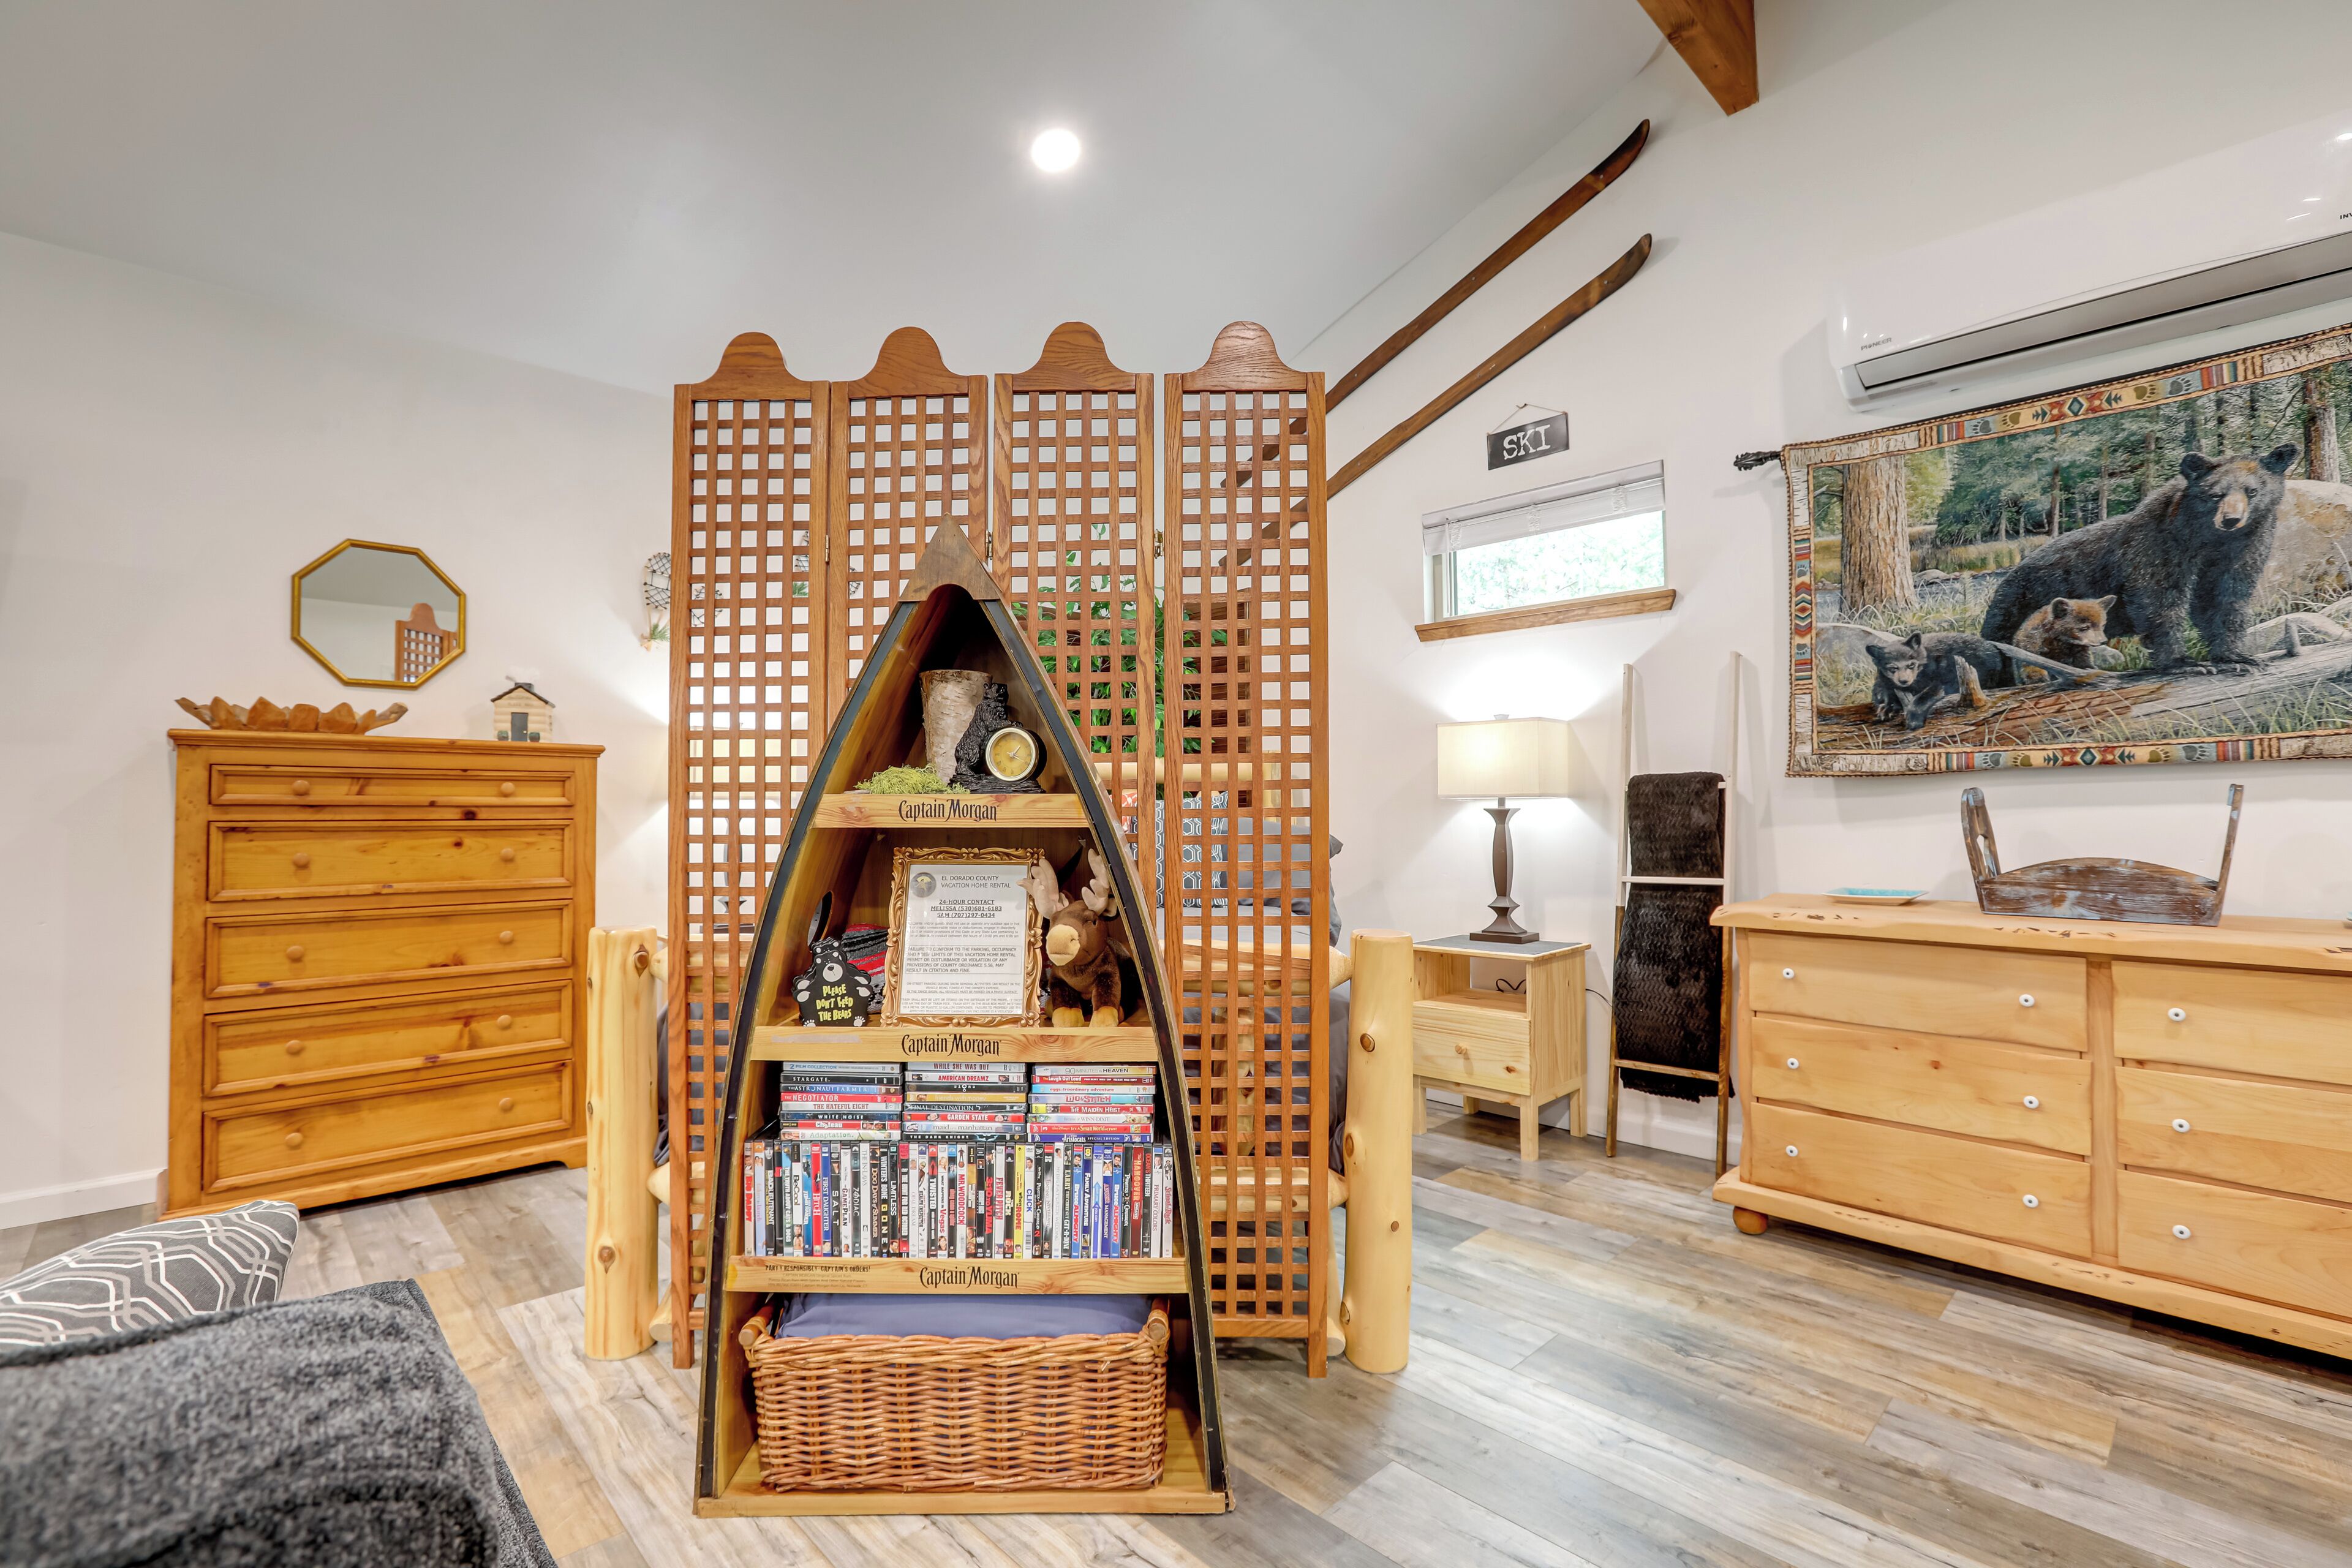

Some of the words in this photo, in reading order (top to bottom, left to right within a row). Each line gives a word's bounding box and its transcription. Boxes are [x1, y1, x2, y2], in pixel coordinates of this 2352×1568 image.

[1861, 337, 1891, 350] PIONEER
[1504, 424, 1550, 459] SKI
[899, 799, 944, 822] Captain
[944, 799, 997, 822] Morgan
[823, 984, 846, 997] PLEASE
[816, 998, 835, 1009] DON'T
[837, 996, 853, 1008] FEED
[818, 1011, 831, 1022] THE
[833, 1009, 851, 1020] BEARS
[902, 1034, 947, 1056] Captain
[947, 1034, 1000, 1057] Morgan
[919, 1267, 965, 1288] Captain
[965, 1267, 1017, 1289] Morgan
